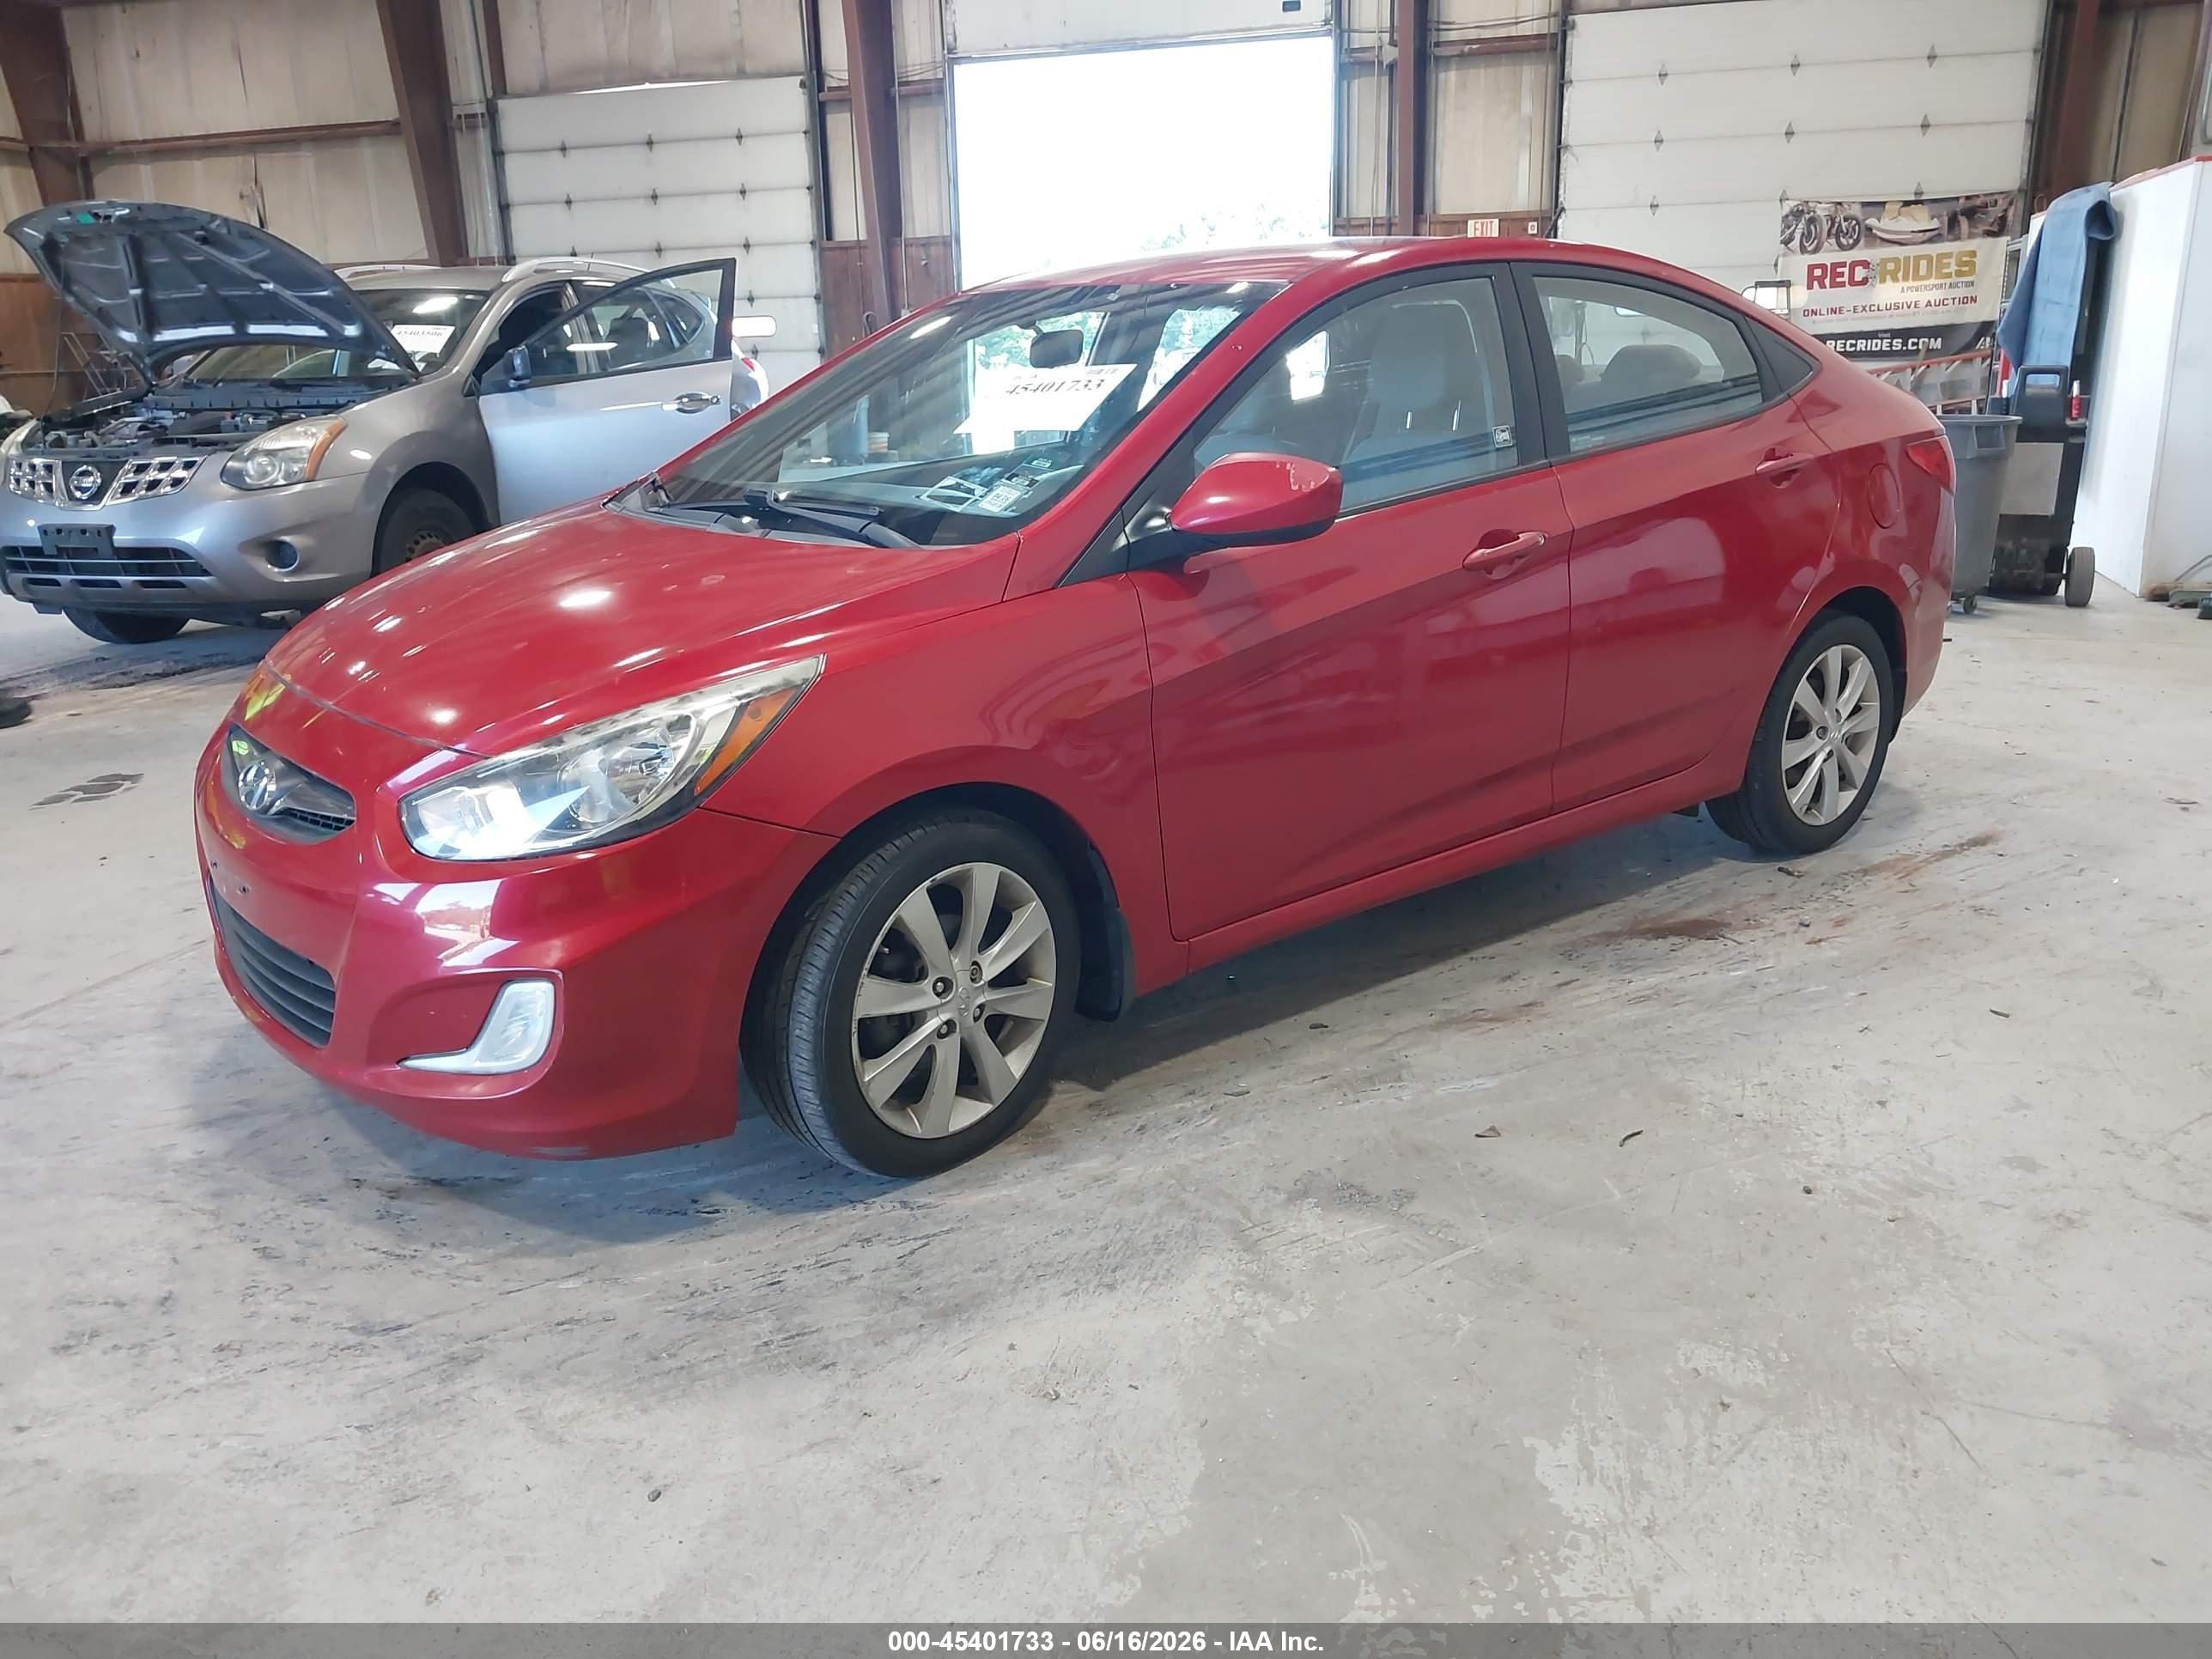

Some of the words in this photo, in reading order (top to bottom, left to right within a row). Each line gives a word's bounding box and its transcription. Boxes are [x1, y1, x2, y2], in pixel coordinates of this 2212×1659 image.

[1474, 221, 1494, 236] EXIT
[1808, 259, 1869, 290] REC
[1879, 250, 1977, 284] RIDES
[1905, 283, 1948, 293] POWERSPORT
[1948, 281, 1975, 289] AUCTION
[1802, 300, 1920, 318] ONLINE-EXCLUSIVE
[1925, 295, 1978, 308] AUCTION
[1006, 379, 1105, 394] 45401733
